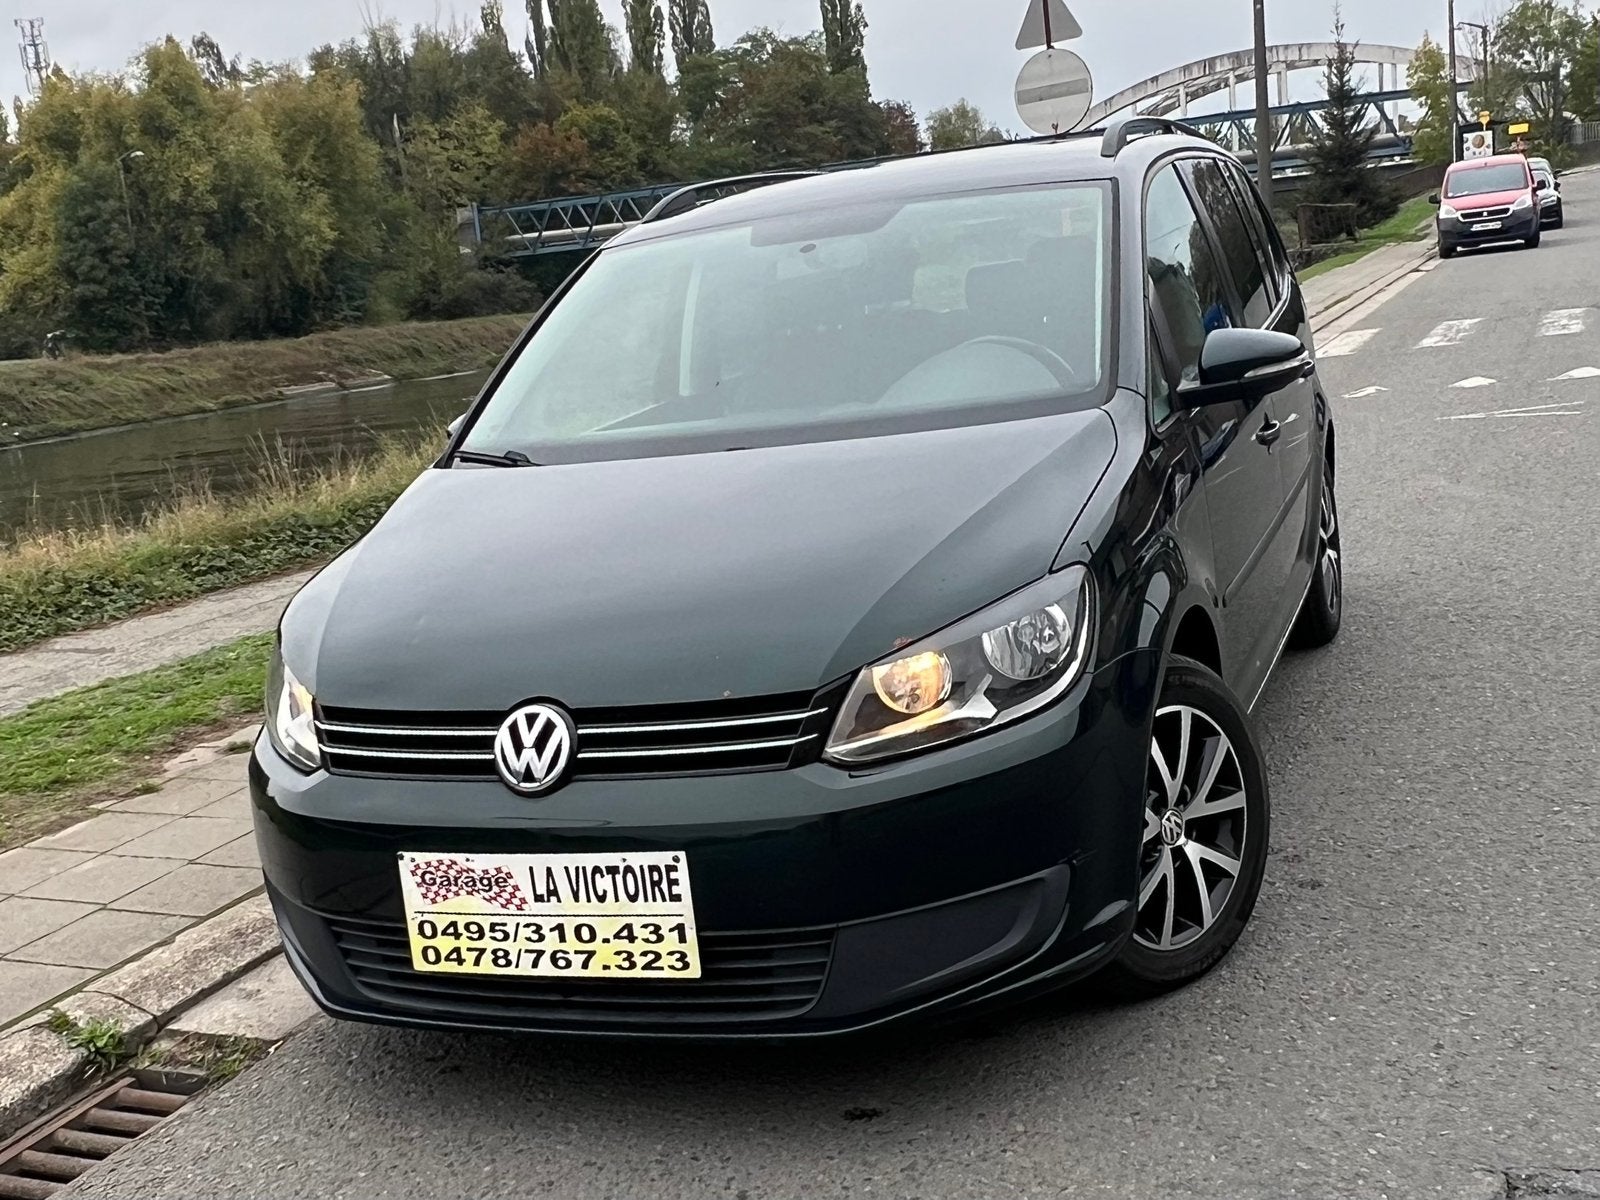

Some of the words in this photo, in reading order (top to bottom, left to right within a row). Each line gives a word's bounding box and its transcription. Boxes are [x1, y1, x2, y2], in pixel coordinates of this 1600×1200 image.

[420, 870, 511, 892] Garage
[528, 865, 562, 903] LA
[564, 864, 682, 903] VICTOIRE
[417, 920, 688, 944] 0495/310.431
[421, 945, 691, 972] 0478/767.323
